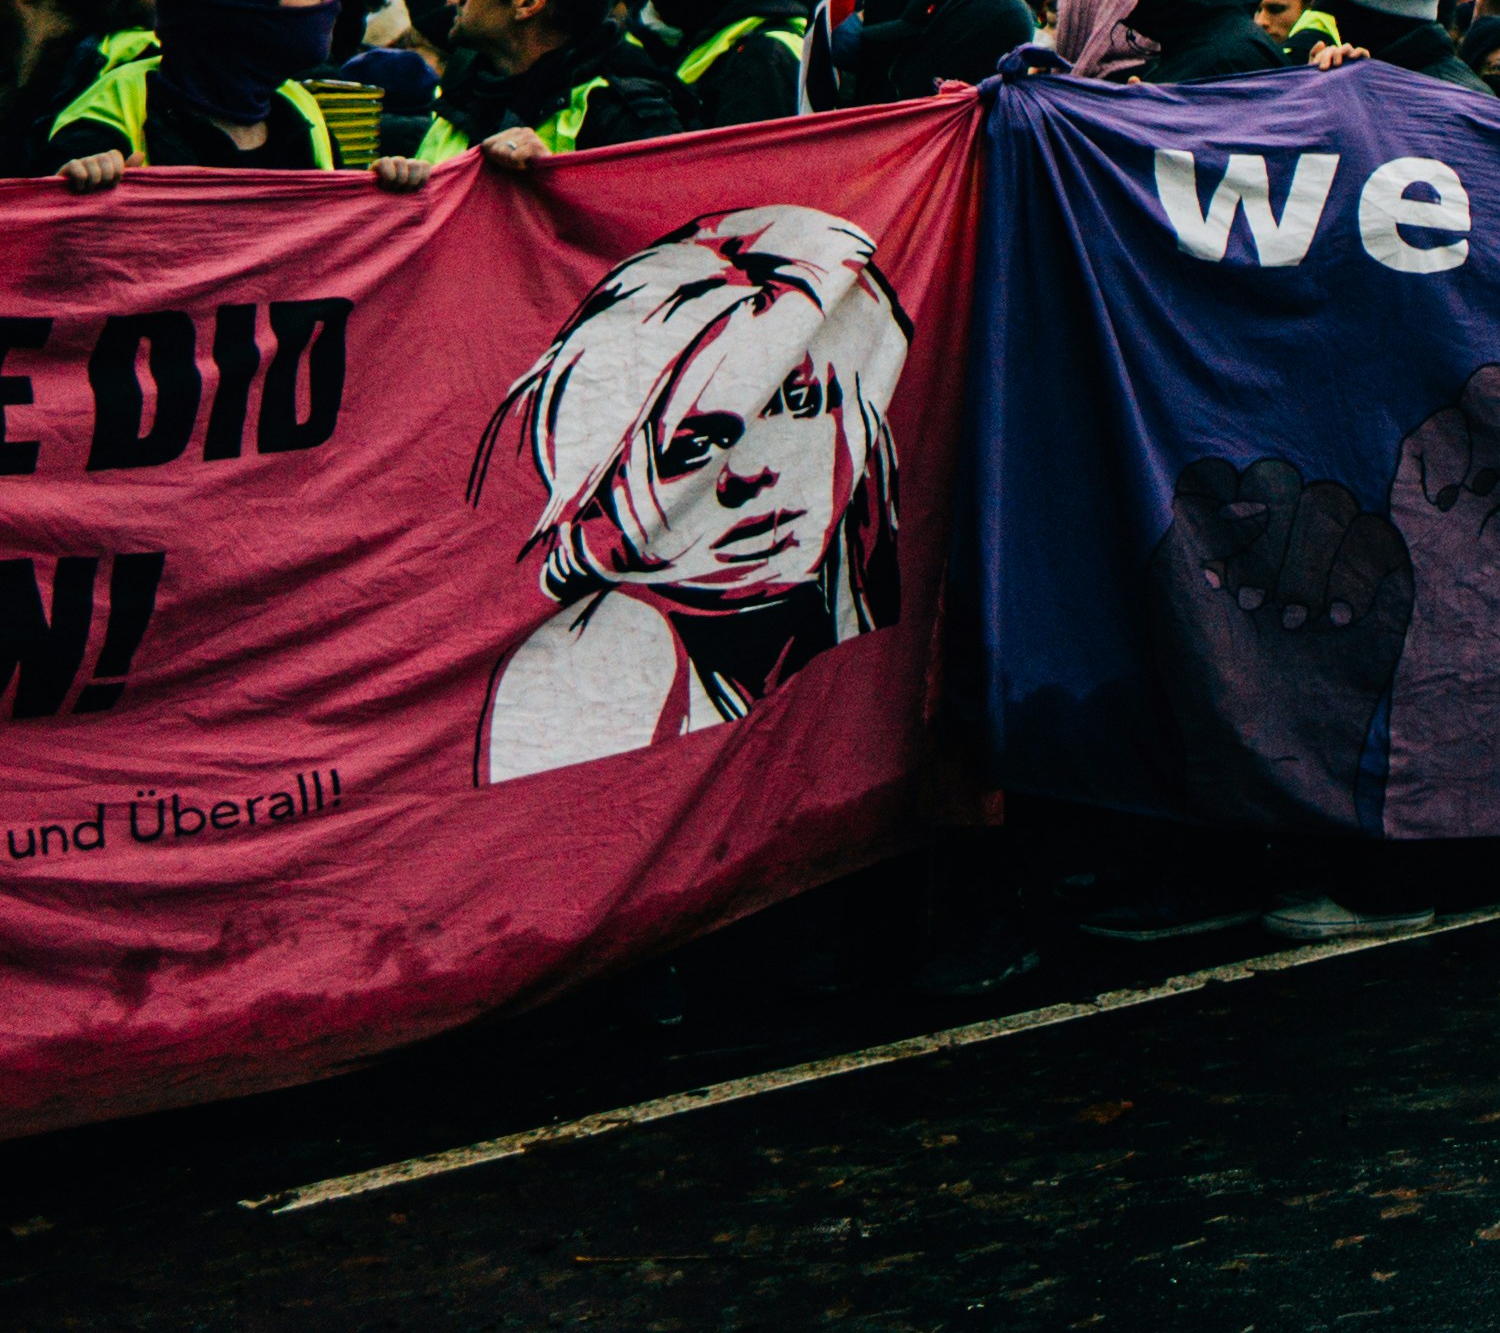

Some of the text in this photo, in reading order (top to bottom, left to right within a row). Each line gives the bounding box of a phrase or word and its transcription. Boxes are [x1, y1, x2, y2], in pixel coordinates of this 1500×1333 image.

[1154, 148, 1472, 275] we
[0, 297, 355, 476] E DID
[6, 768, 343, 861] und Überall!
